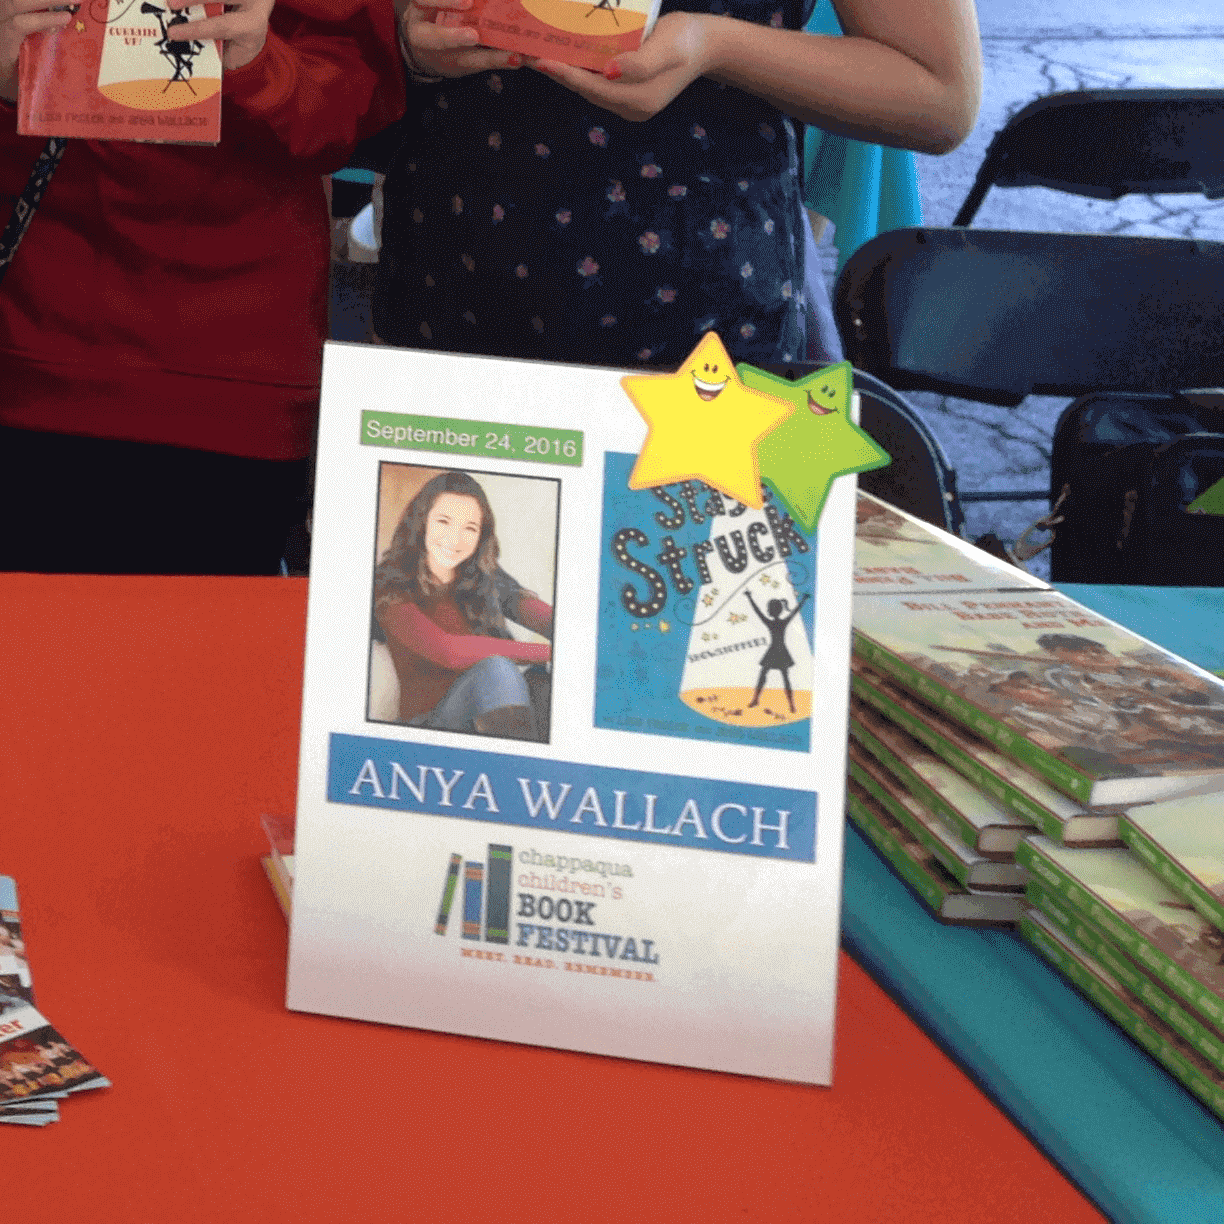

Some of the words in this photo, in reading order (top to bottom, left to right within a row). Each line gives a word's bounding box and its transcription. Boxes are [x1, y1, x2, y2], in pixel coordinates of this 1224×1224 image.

[366, 419, 479, 447] September
[524, 435, 577, 458] 2016
[347, 757, 500, 816] ANYA
[516, 776, 793, 852] WALLACH
[517, 847, 634, 878] chappaqua
[517, 871, 624, 901] children's
[516, 892, 597, 926] BOOK
[515, 922, 661, 965] FESTIVAL
